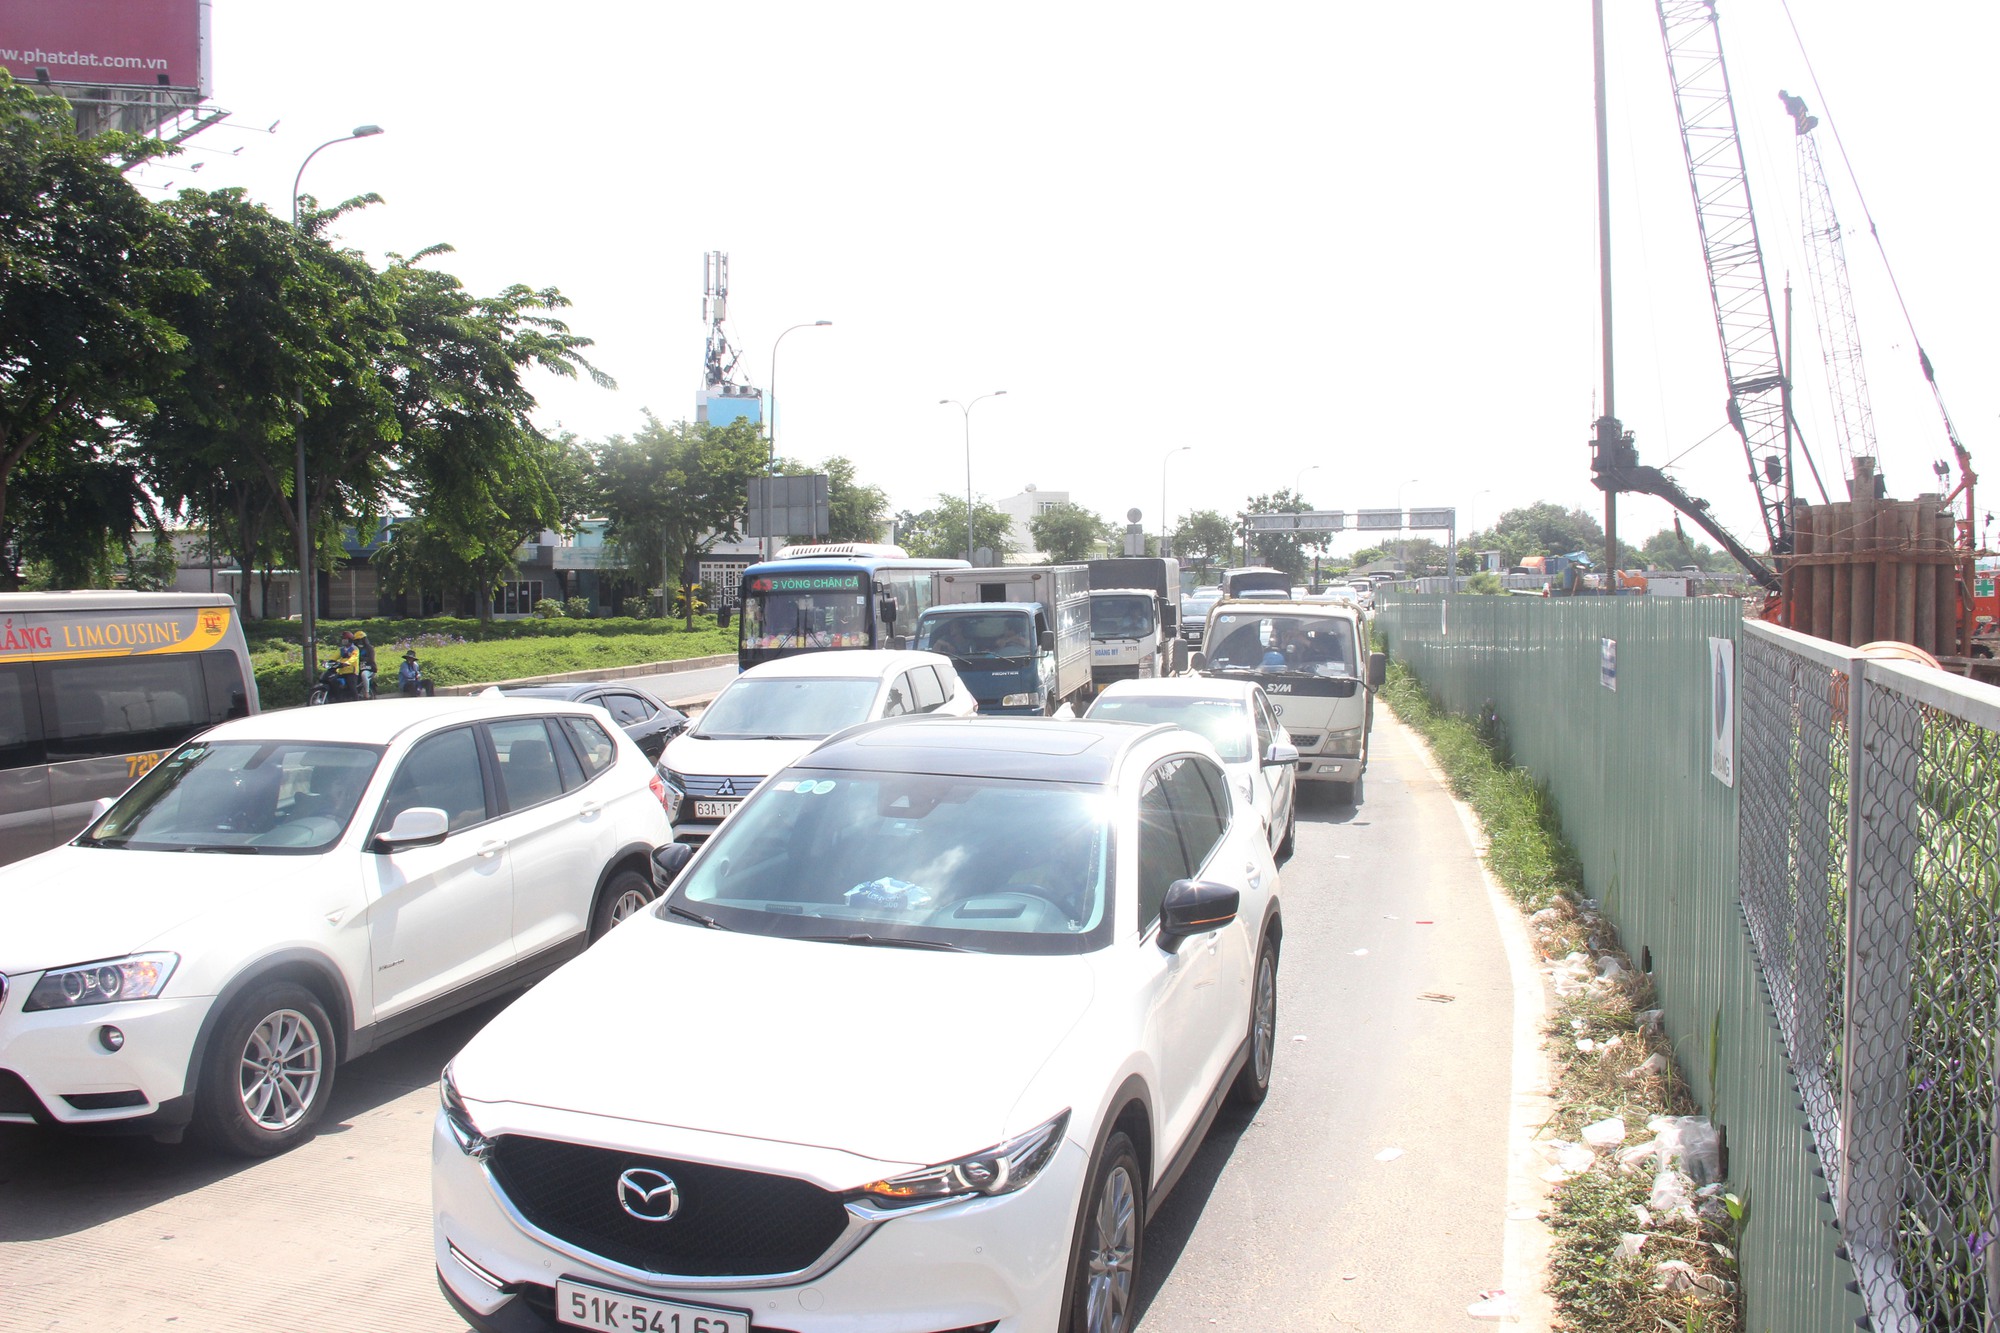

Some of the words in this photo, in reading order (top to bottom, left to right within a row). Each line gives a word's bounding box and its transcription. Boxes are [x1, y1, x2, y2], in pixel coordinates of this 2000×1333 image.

[0, 48, 168, 70] w.phatdat.com.vn
[0, 618, 52, 650] ẮNG
[63, 622, 182, 647] LIMOUSINE
[1266, 683, 1292, 693] SYM
